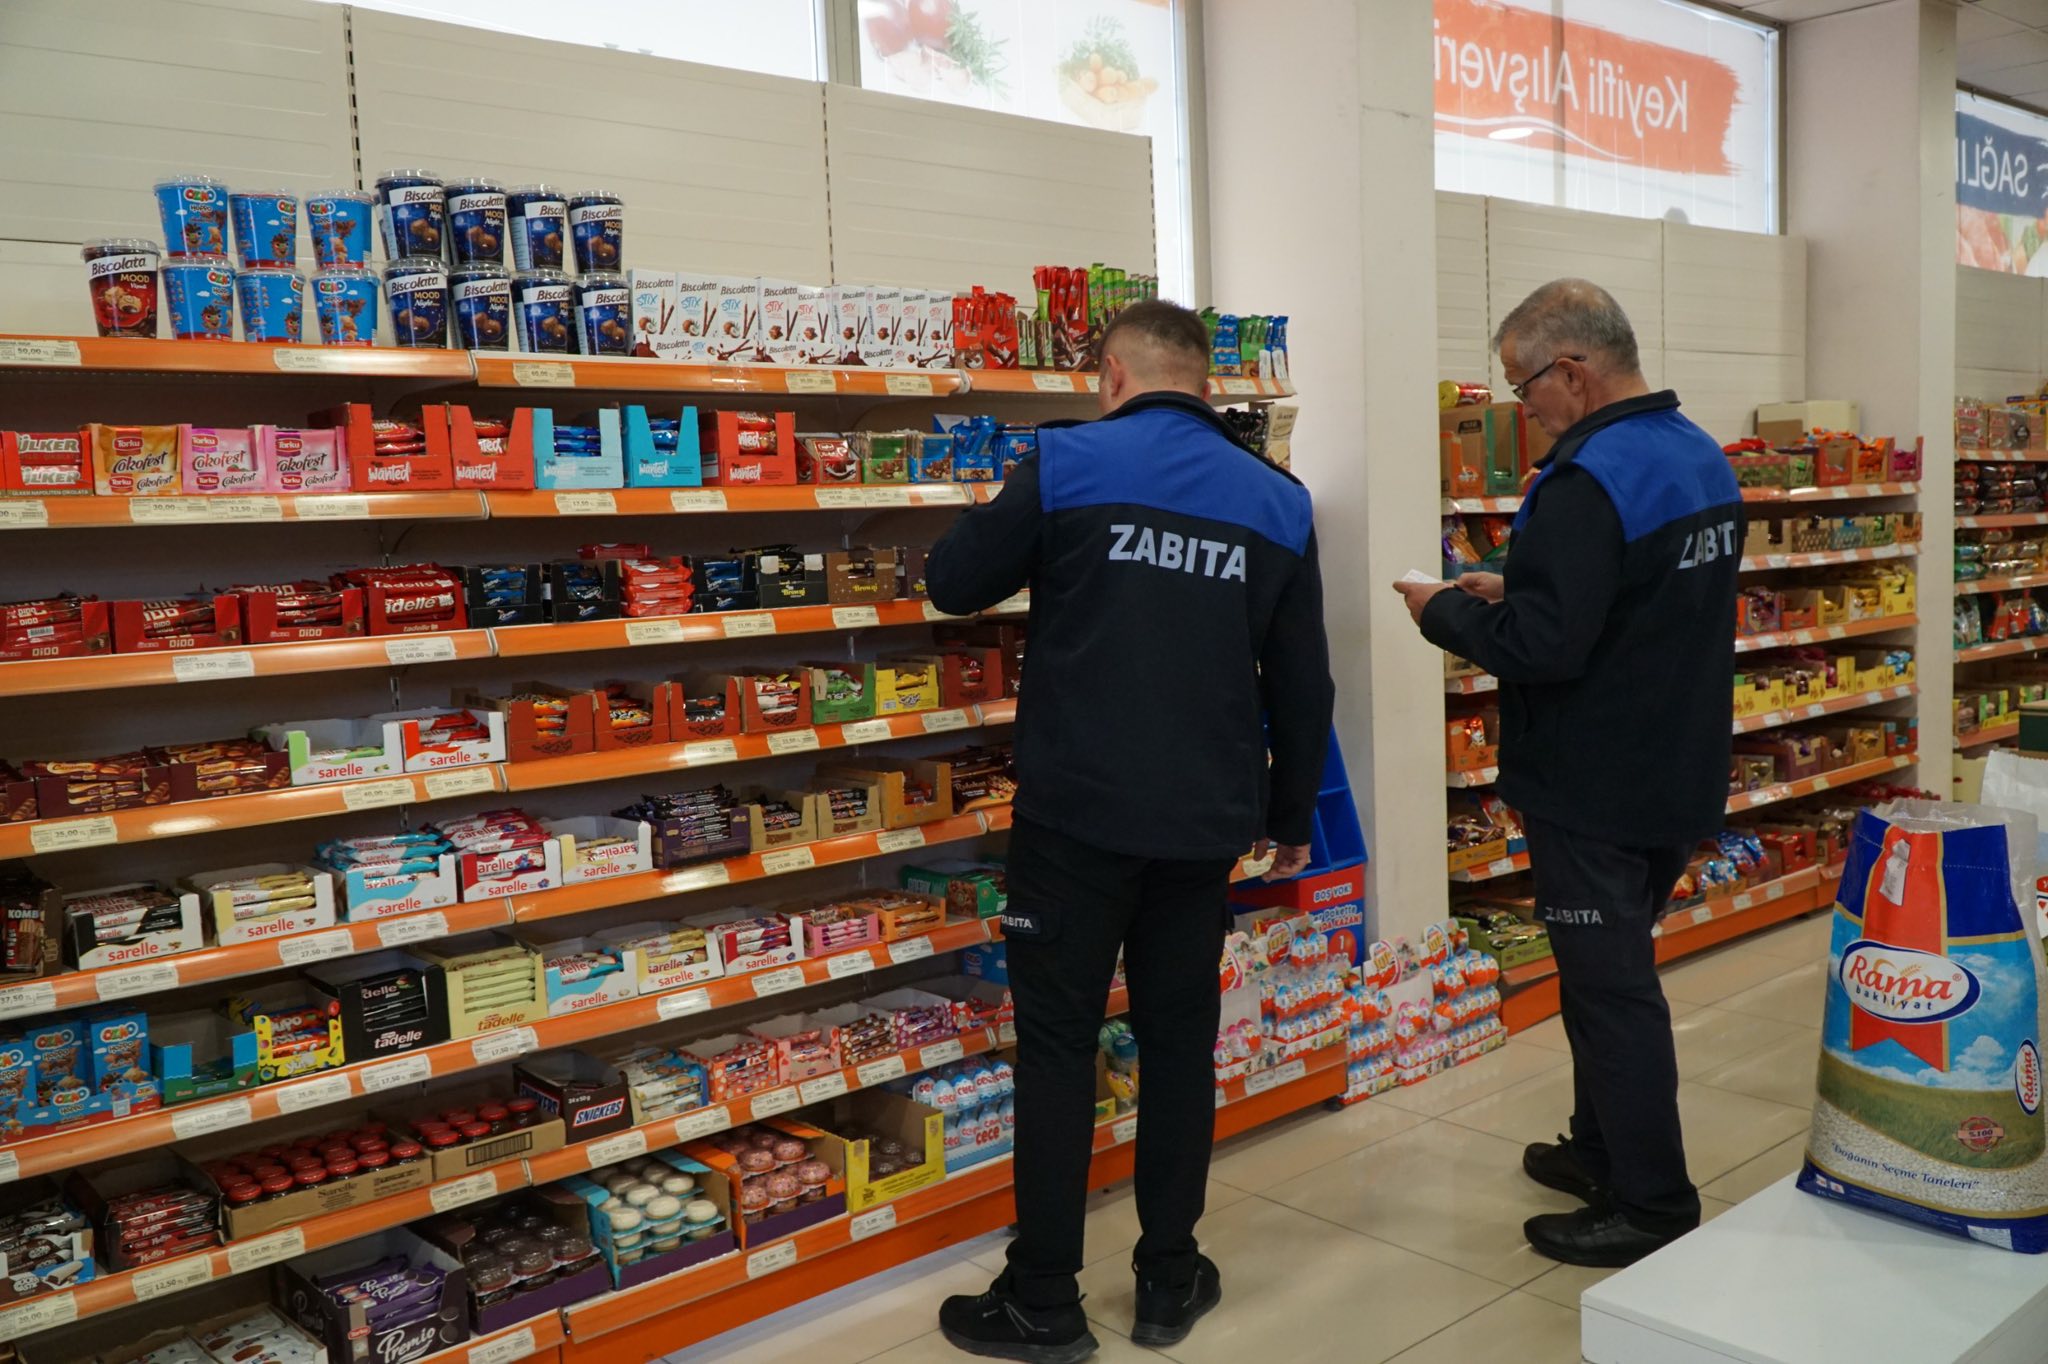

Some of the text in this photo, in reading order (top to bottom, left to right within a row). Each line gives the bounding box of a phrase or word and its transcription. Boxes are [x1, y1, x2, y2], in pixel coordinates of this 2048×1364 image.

[91, 256, 146, 276] Biscolata
[120, 274, 150, 283] MOOD
[391, 276, 438, 294] Biscolata
[635, 279, 674, 290] Biscolata
[680, 282, 717, 293] Biscolata
[720, 285, 756, 296] Biscolata
[764, 286, 798, 297] Biscolata
[656, 340, 690, 351] Biscolata
[117, 438, 141, 448] Torku
[277, 441, 301, 449] Torku
[110, 478, 132, 486] Torku
[198, 477, 218, 485] Torku
[283, 477, 302, 485] Torku
[1108, 524, 1246, 583] ZABITA
[429, 752, 471, 767] sarelle
[318, 763, 364, 779] sarelle
[584, 863, 621, 877] sarelle
[489, 880, 528, 896] sarelle
[1313, 889, 1332, 903] BOŞ
[377, 897, 422, 915] sarelle
[1545, 906, 1603, 925] ZABITA
[248, 918, 295, 938] sarelle
[108, 942, 160, 962] sarelle
[300, 949, 321, 958] 27,50
[745, 954, 778, 970] sarelle
[658, 970, 694, 986] sarelle
[1849, 955, 1954, 1000] Rama
[571, 992, 608, 1009] sarelle
[1855, 985, 1933, 1011] bakliyat
[477, 1012, 525, 1032] tadelle
[374, 1030, 423, 1049] tadelle
[380, 1075, 401, 1085] 17,50
[576, 1100, 622, 1124] SNICKERS
[1881, 1162, 1918, 1181] Seçme
[155, 1278, 177, 1291] 12,50
[18, 1311, 43, 1324] 20,00
[377, 1326, 436, 1364] Premio
